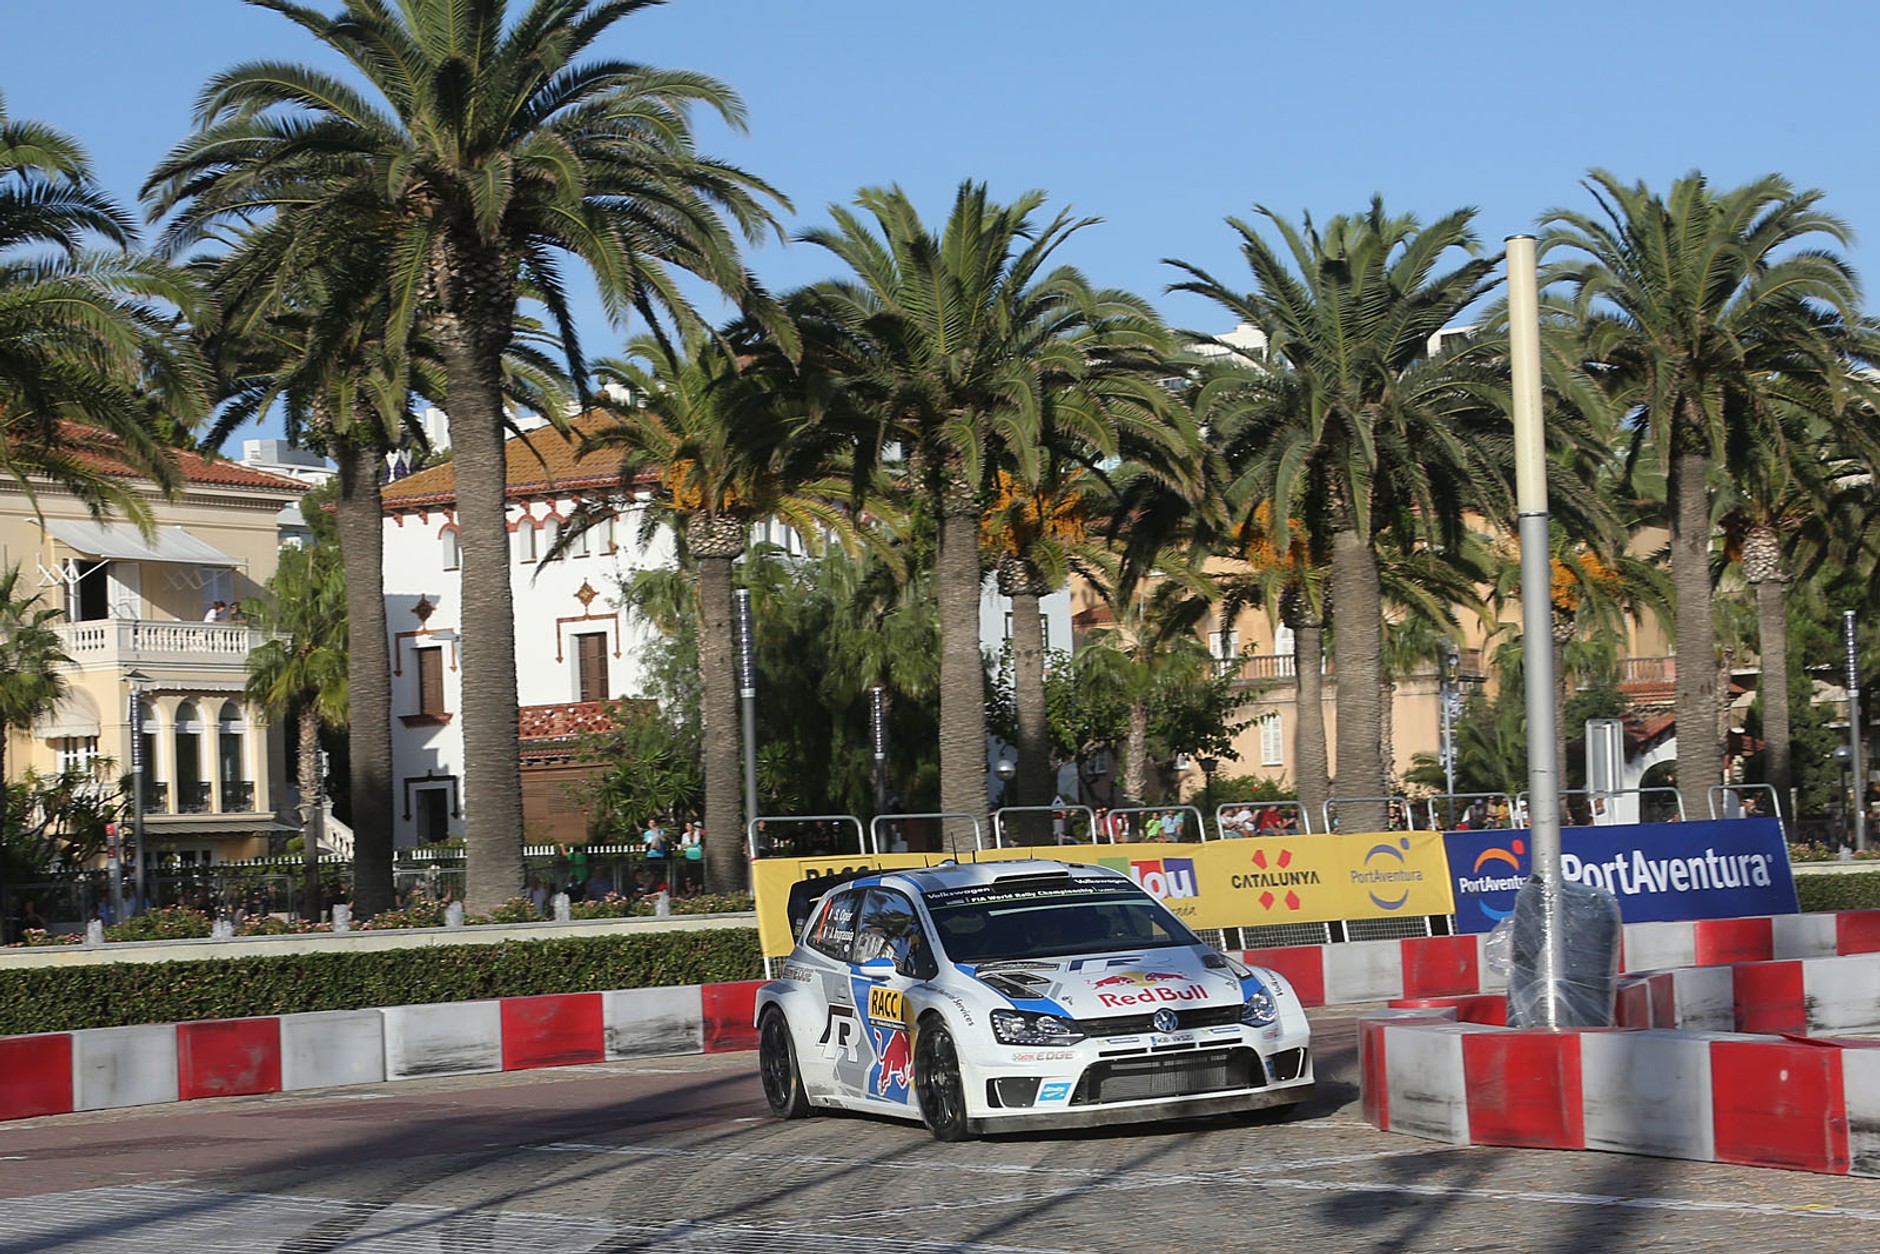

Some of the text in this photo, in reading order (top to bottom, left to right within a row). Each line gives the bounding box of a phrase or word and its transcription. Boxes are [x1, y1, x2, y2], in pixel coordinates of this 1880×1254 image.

[1231, 870, 1320, 889] CATALUNYA
[1351, 869, 1424, 884] PortAventura
[1560, 848, 1772, 895] PortAventura
[927, 886, 991, 899] Volkswagen
[1130, 866, 1196, 900] lou
[871, 989, 898, 1019] RACC
[1097, 984, 1209, 1007] Red Bull
[1036, 1050, 1075, 1061] EDGE
